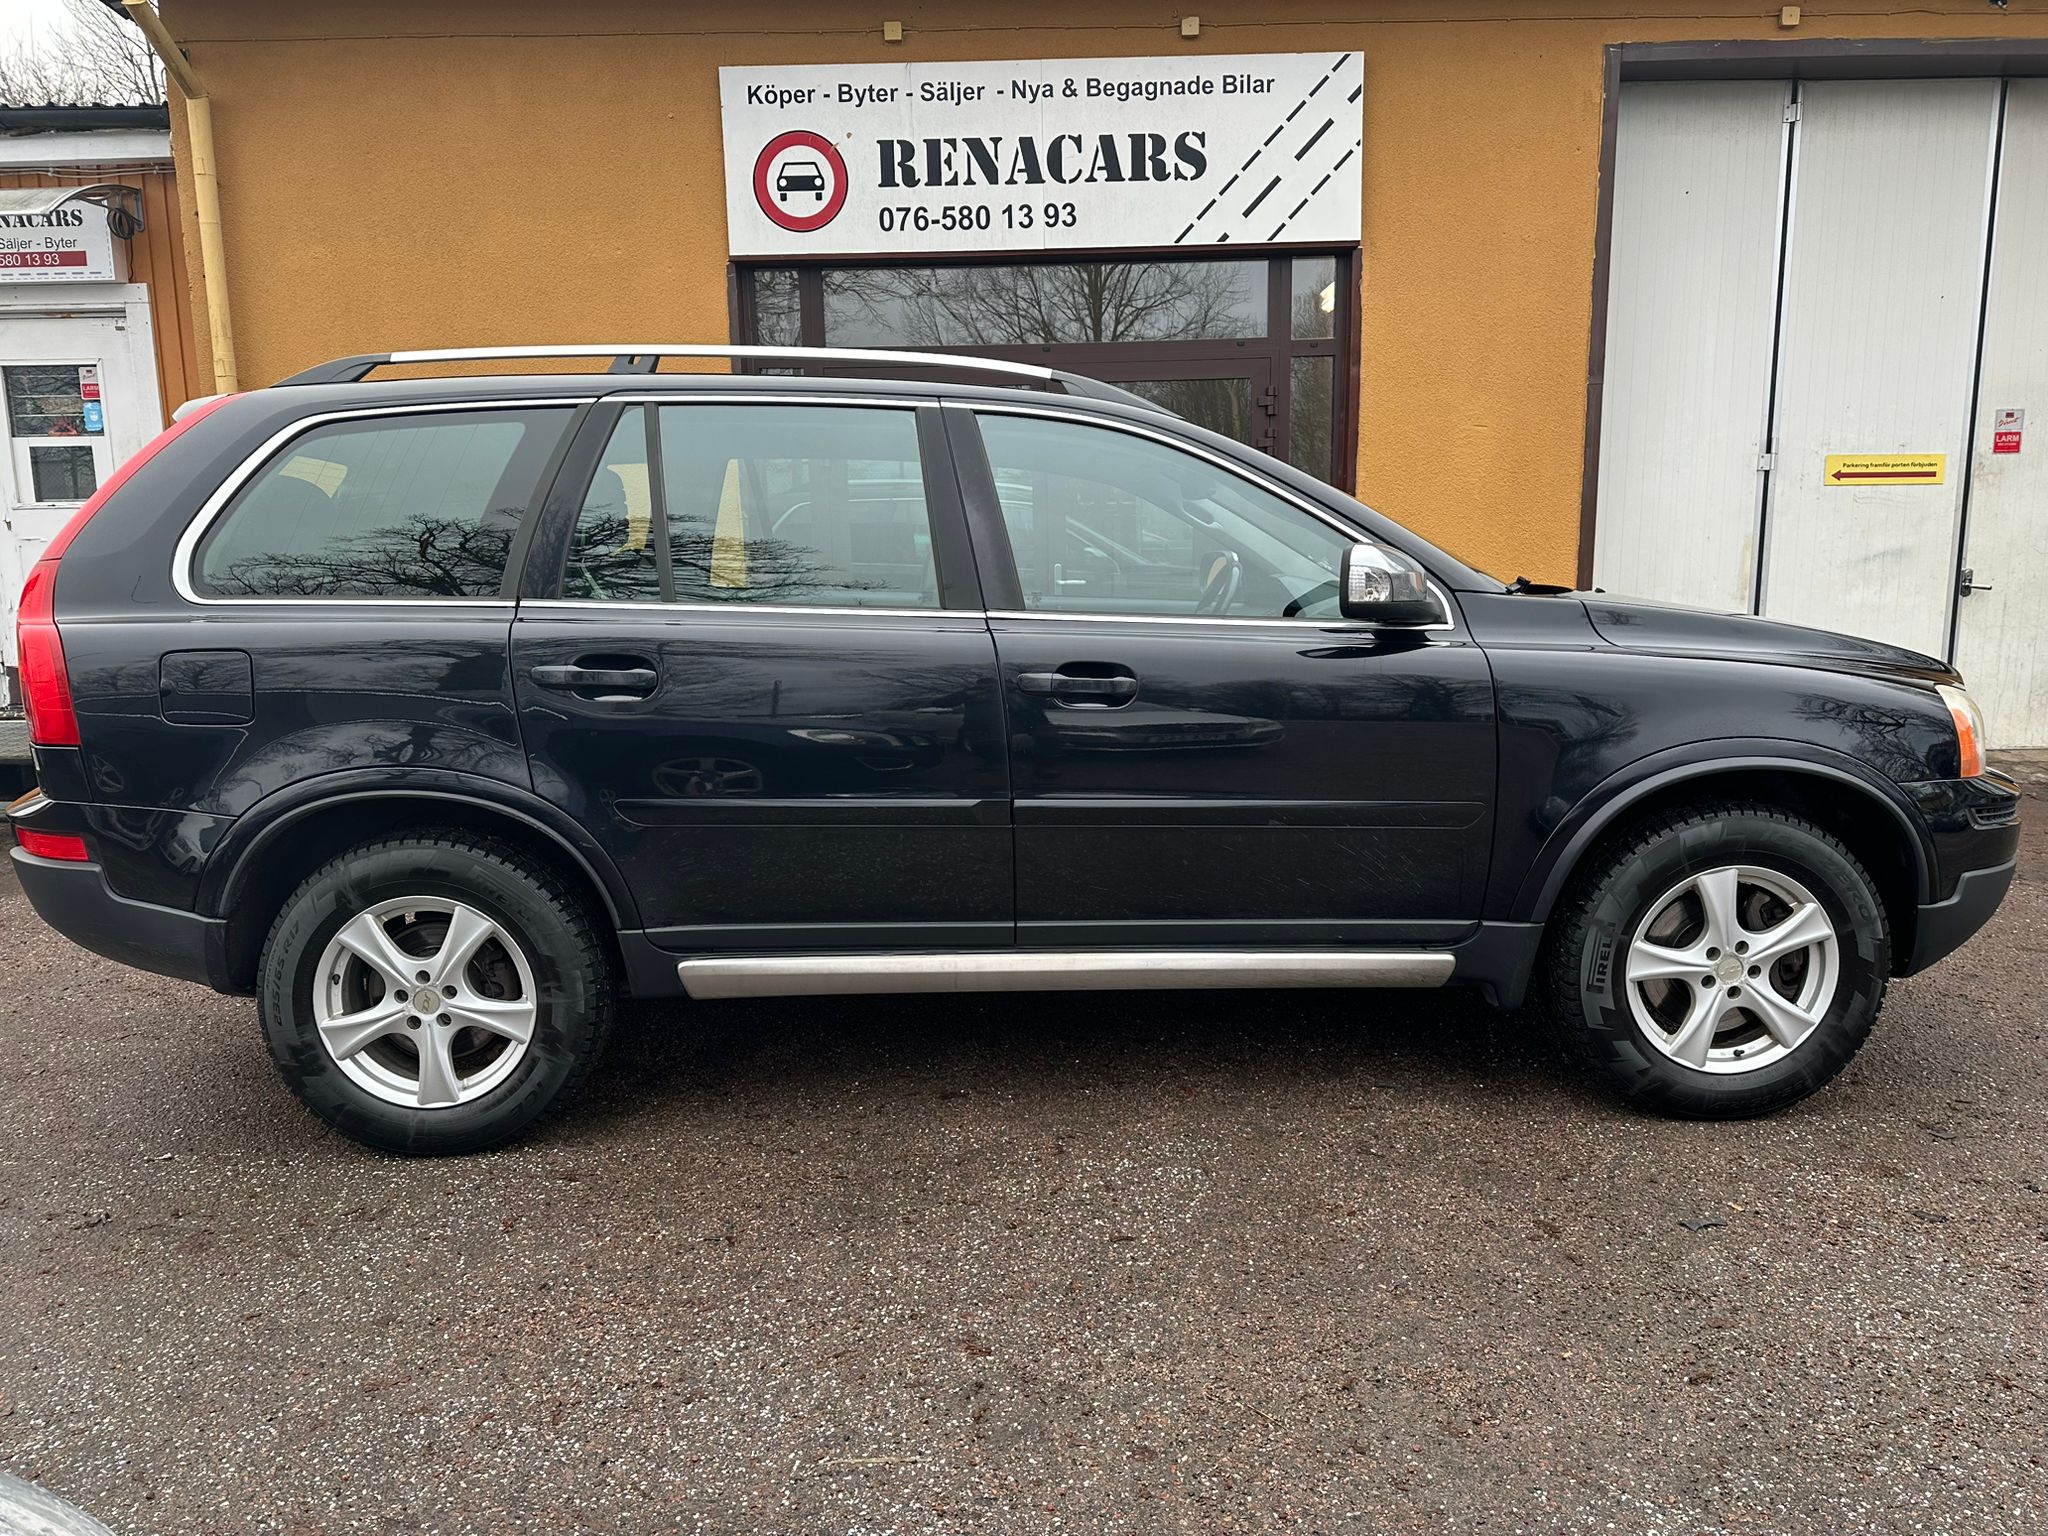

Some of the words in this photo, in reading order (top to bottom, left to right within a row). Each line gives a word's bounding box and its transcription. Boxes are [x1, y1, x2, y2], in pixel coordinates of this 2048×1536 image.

[747, 84, 816, 109] Köper
[837, 83, 899, 108] Byter
[920, 81, 986, 106] Säljer
[1011, 79, 1054, 104] Nya
[1062, 78, 1078, 98] &
[1086, 76, 1214, 102] Begagnade
[1222, 74, 1275, 94] Bilar
[877, 132, 1207, 188] RENACARS
[879, 205, 991, 232] 076-580
[1001, 203, 1034, 229] 13
[1043, 202, 1077, 228] 93
[25, 254, 41, 266] 13
[43, 253, 60, 266] 93
[44, 236, 78, 251] Byter
[1996, 434, 2020, 442] LARM
[271, 955, 286, 1027] 235/65
[282, 918, 301, 955] R17
[1586, 921, 1617, 994] PIRELI
